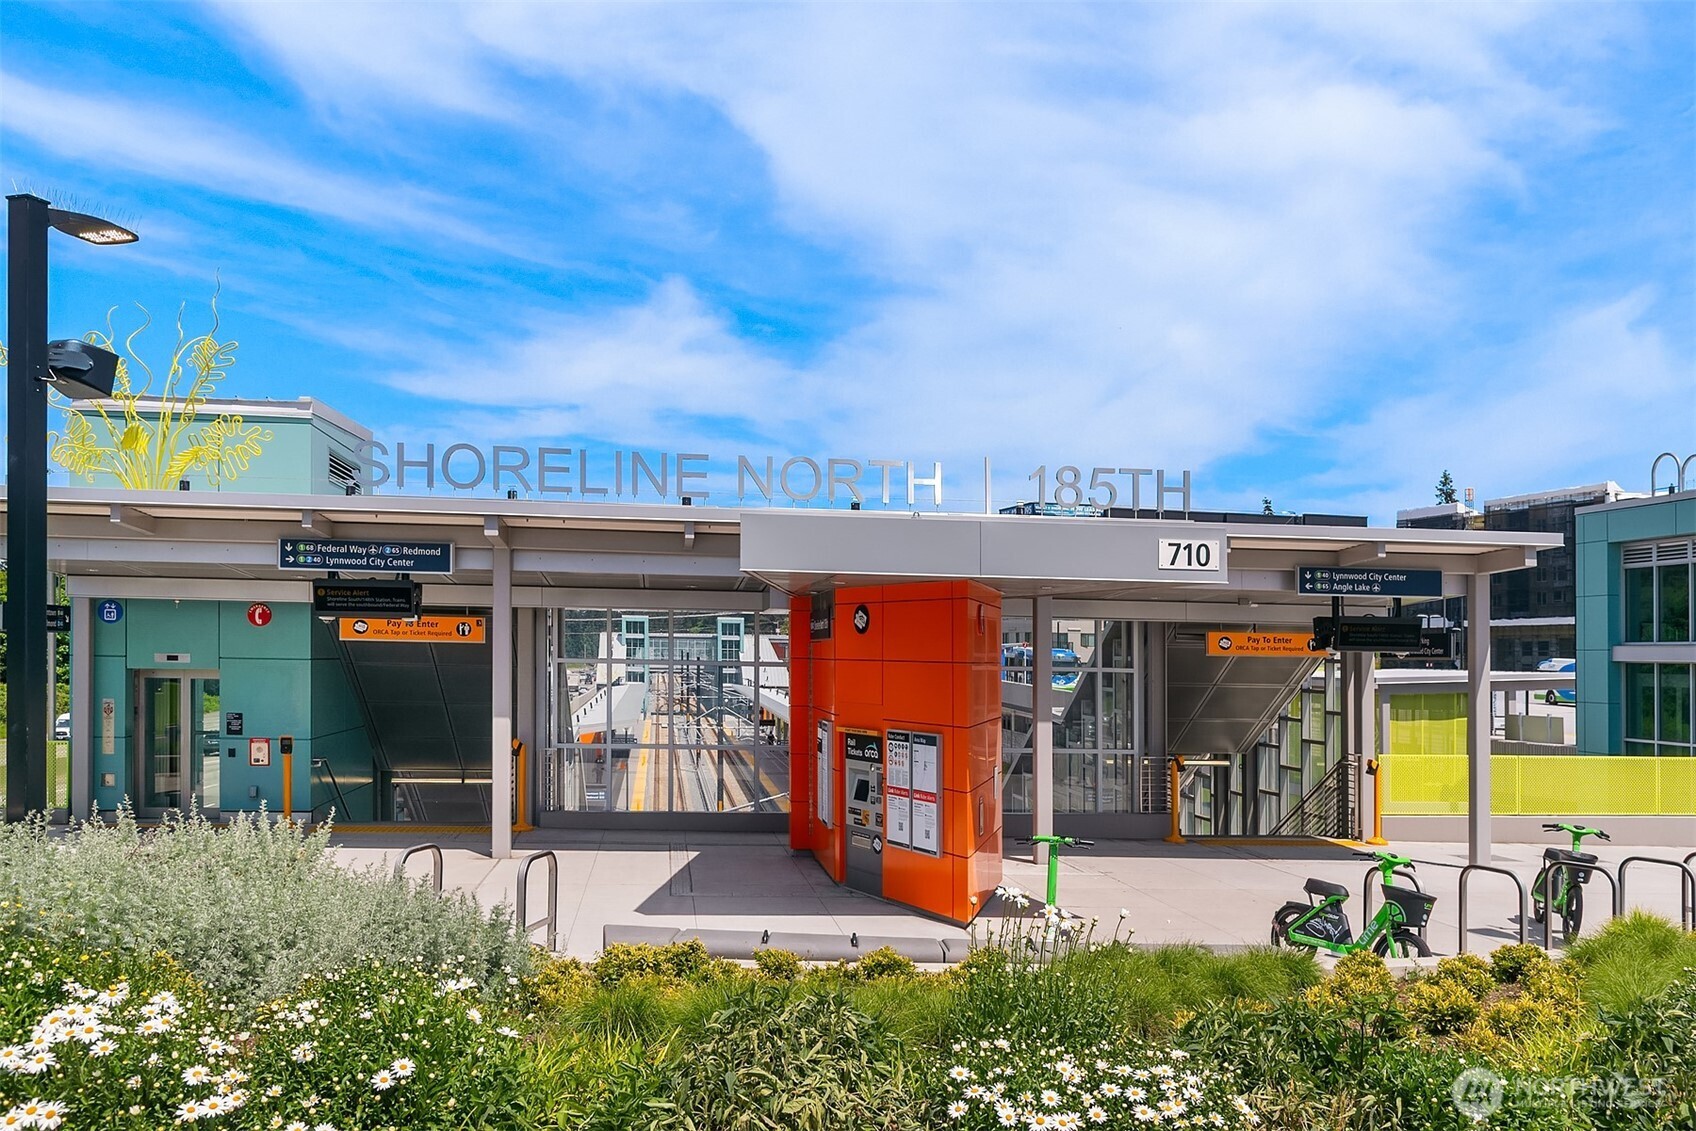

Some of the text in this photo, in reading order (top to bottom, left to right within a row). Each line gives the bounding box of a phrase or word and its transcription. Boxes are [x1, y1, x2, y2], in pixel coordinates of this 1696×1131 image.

[351, 440, 1191, 513] SHORELINE NORTH 185TH
[317, 544, 348, 553] Federal
[349, 546, 367, 556] Way
[402, 546, 441, 556] Redmond
[1167, 542, 1212, 567] 710
[326, 556, 367, 566] Lynnwood
[369, 557, 386, 568] City
[387, 557, 415, 567] Center
[1332, 572, 1368, 582] Lynnwood
[1368, 572, 1383, 582] City
[1383, 573, 1407, 581] Center
[1332, 583, 1353, 593] Angle
[1354, 583, 1371, 591] Lake
[386, 619, 401, 629] Pay
[416, 620, 439, 629] Enter
[390, 629, 401, 637] Tap
[427, 630, 453, 638] Required
[1247, 636, 1293, 645] Pay To Enter
[847, 738, 856, 746] Rail
[847, 747, 879, 758] Tickets orca
[1358, 920, 1379, 946] Lime
